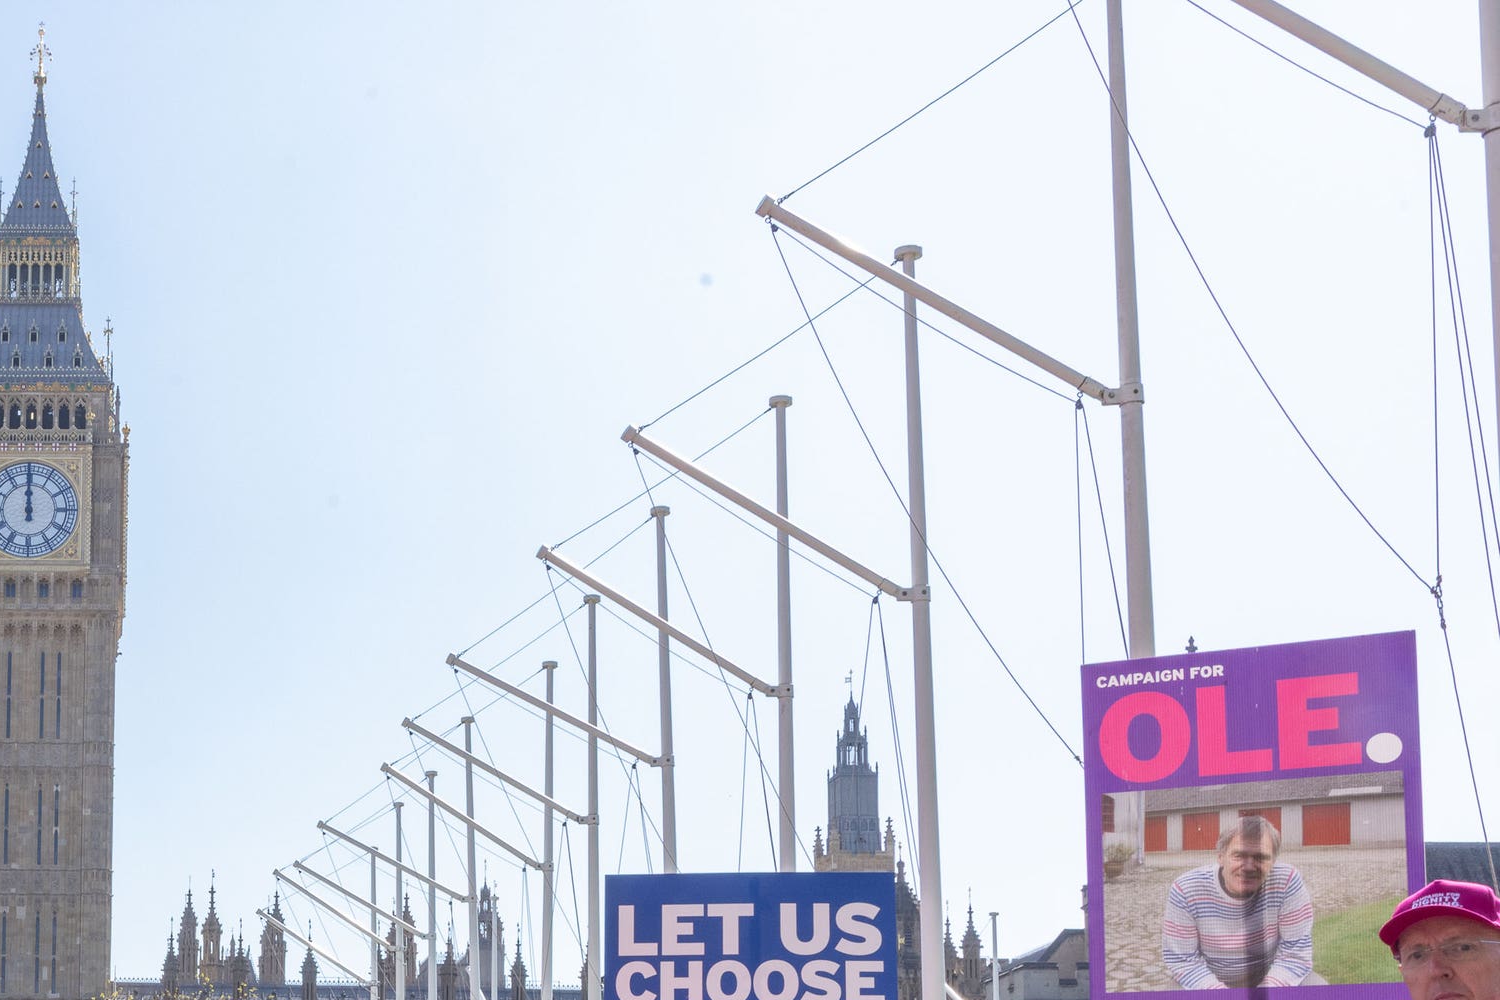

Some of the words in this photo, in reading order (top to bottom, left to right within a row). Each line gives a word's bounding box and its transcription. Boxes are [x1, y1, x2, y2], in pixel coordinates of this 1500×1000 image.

[1096, 669, 1184, 688] CAMPAIGN
[1190, 665, 1224, 680] FOR
[618, 904, 754, 956] LET
[780, 902, 882, 956] US
